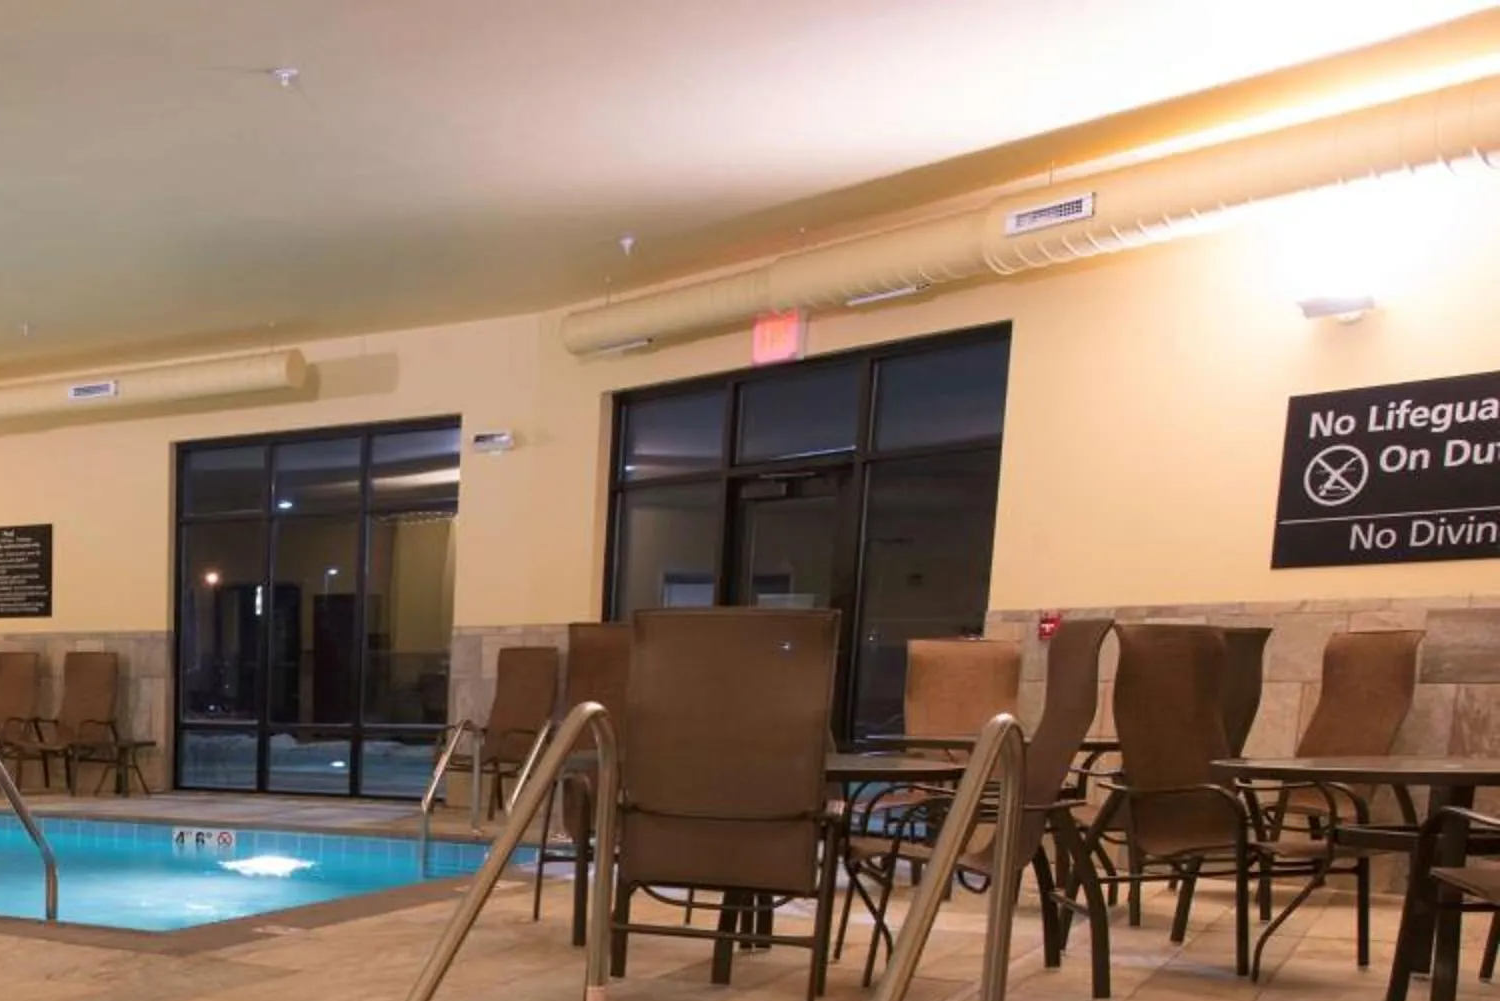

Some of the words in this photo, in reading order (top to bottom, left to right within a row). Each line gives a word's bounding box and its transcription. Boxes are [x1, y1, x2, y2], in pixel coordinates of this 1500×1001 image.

[1308, 410, 1357, 439] No
[1368, 397, 1500, 433] Lifegua
[1378, 444, 1431, 474] On
[1348, 523, 1397, 551] No
[1409, 515, 1500, 548] Divin
